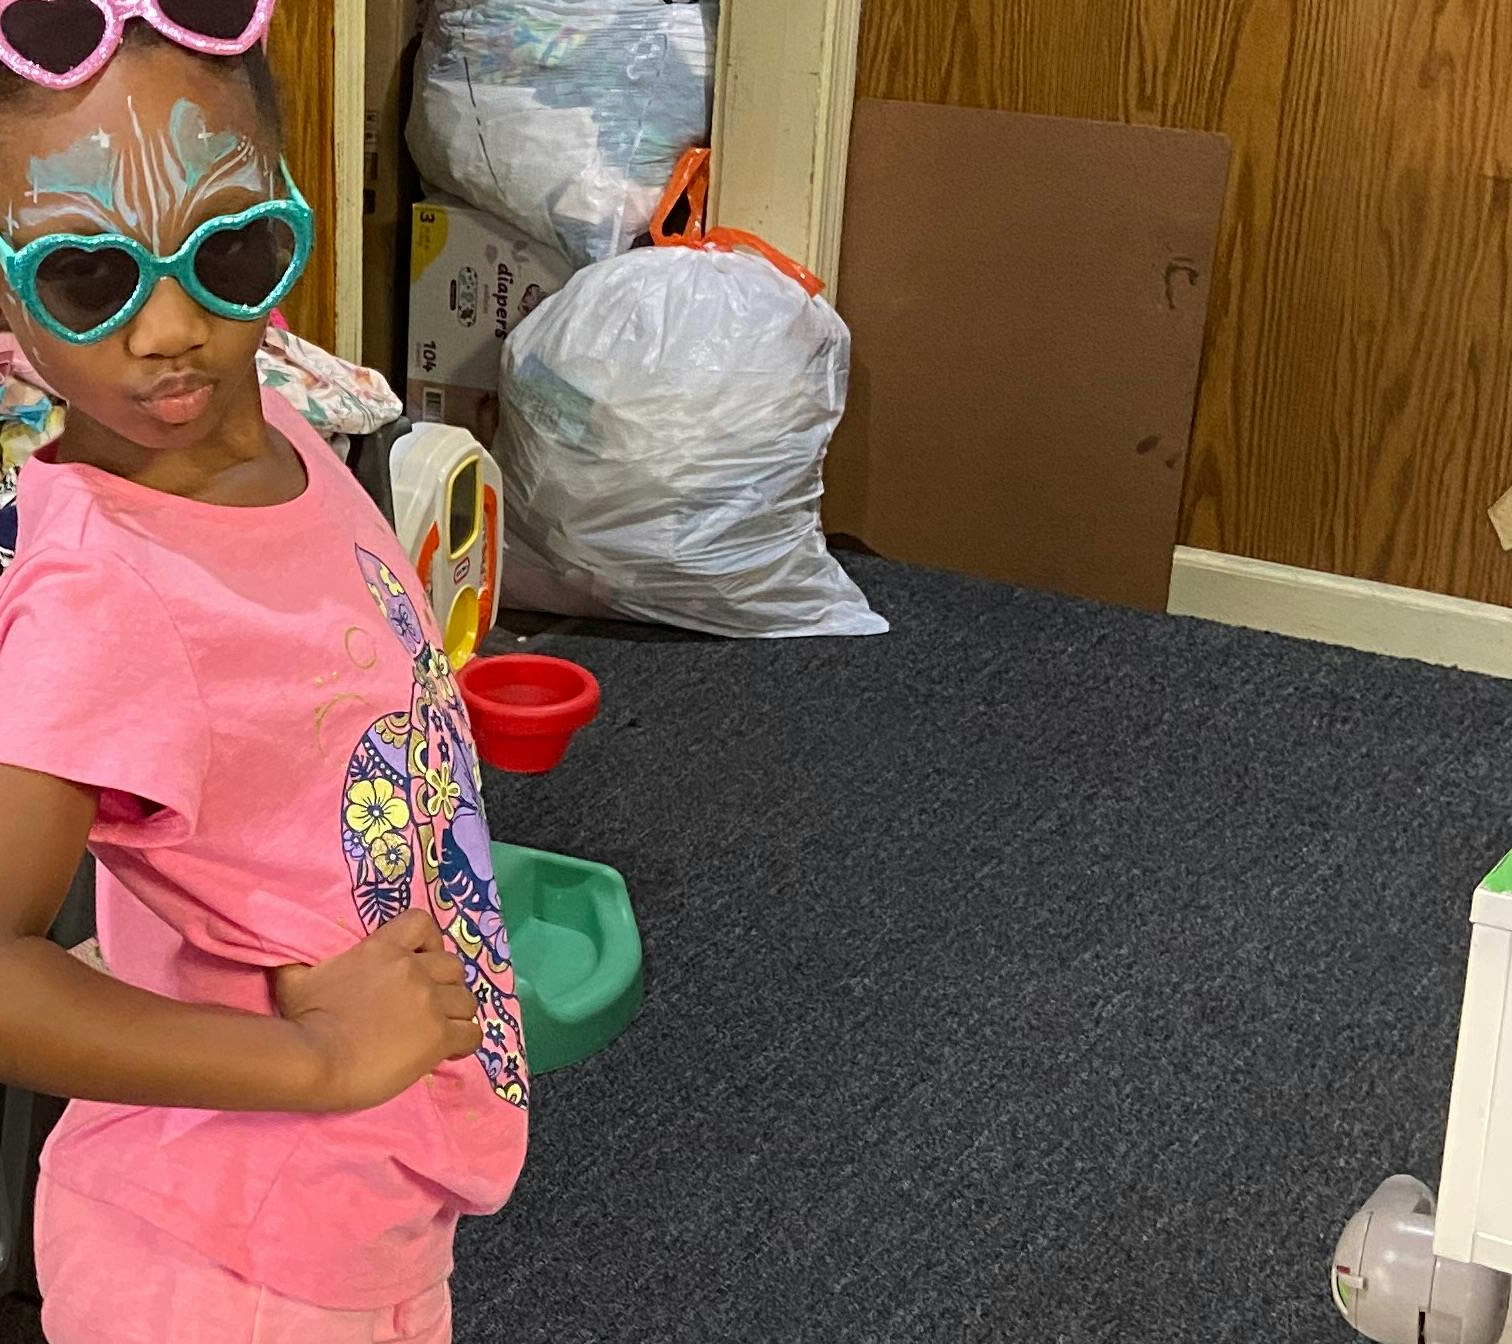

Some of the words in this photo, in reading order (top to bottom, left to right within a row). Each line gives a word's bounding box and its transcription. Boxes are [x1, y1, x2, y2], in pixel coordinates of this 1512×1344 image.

[420, 211, 435, 223] 3
[492, 262, 514, 340] diapers
[422, 340, 437, 373] 104
